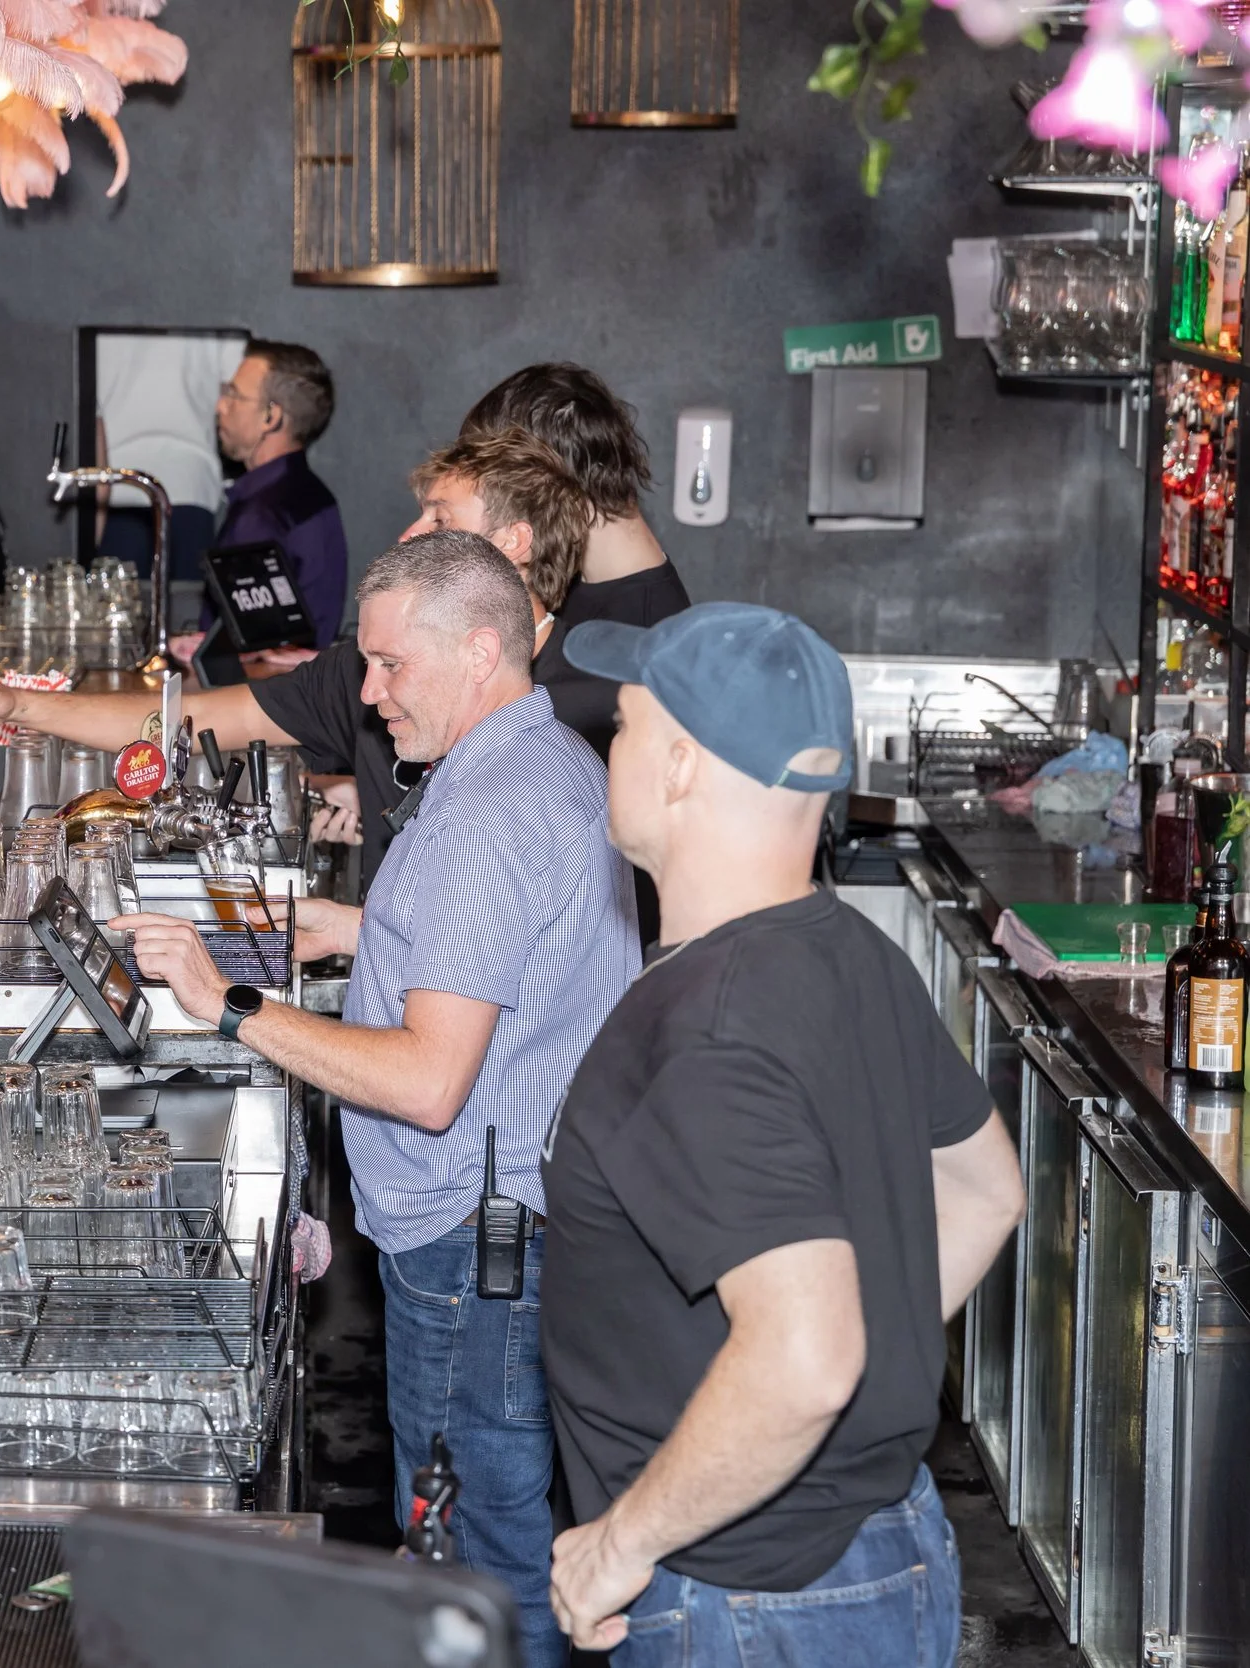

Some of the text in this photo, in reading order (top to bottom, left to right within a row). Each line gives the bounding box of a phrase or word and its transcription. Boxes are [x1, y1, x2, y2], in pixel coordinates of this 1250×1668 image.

[790, 340, 878, 369] First Aid
[231, 585, 274, 612] 16.00
[123, 763, 160, 781] CARLTON
[126, 772, 160, 787] DRAUGHT
